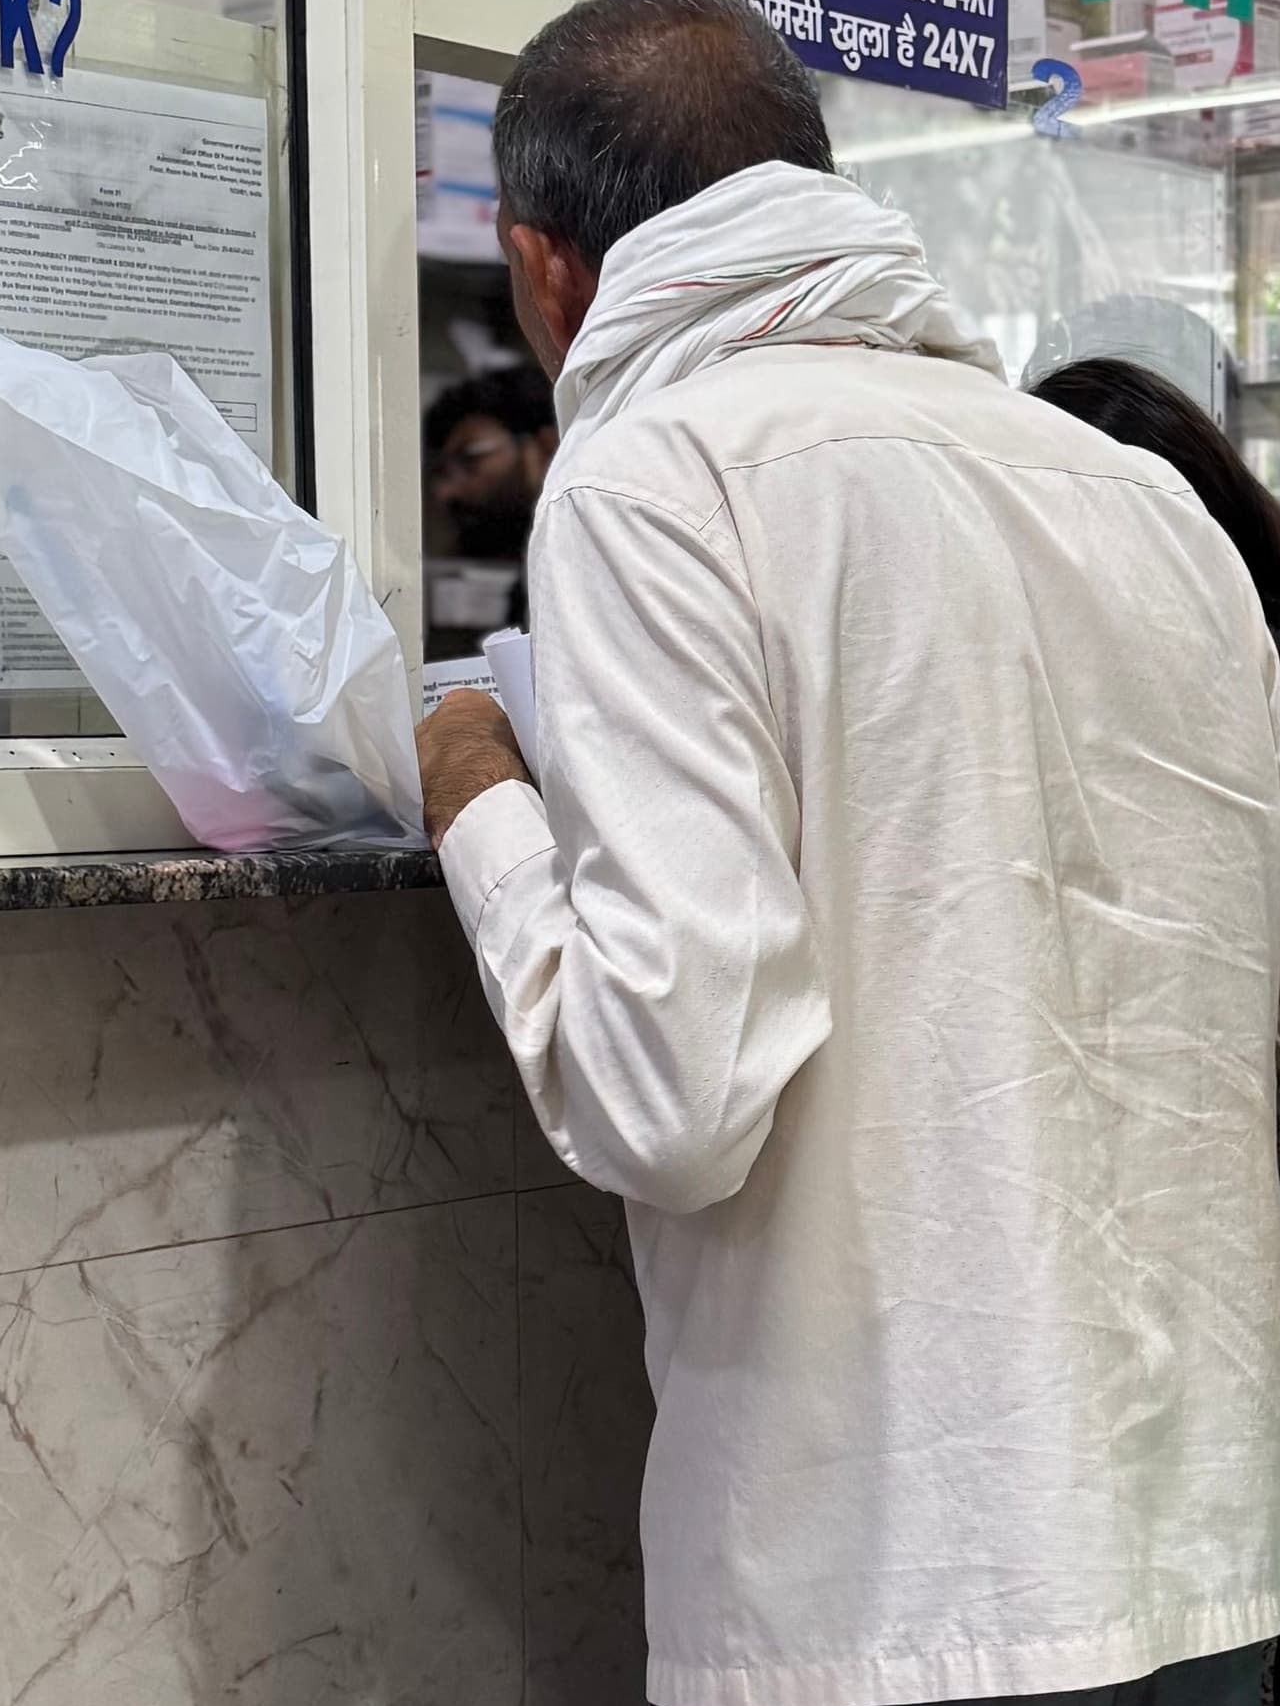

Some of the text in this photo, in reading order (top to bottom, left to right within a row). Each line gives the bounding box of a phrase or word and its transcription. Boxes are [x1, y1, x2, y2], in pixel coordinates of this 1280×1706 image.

[829, 11, 890, 72] खुला
[896, 13, 916, 68] है
[923, 23, 995, 79] 24X7
